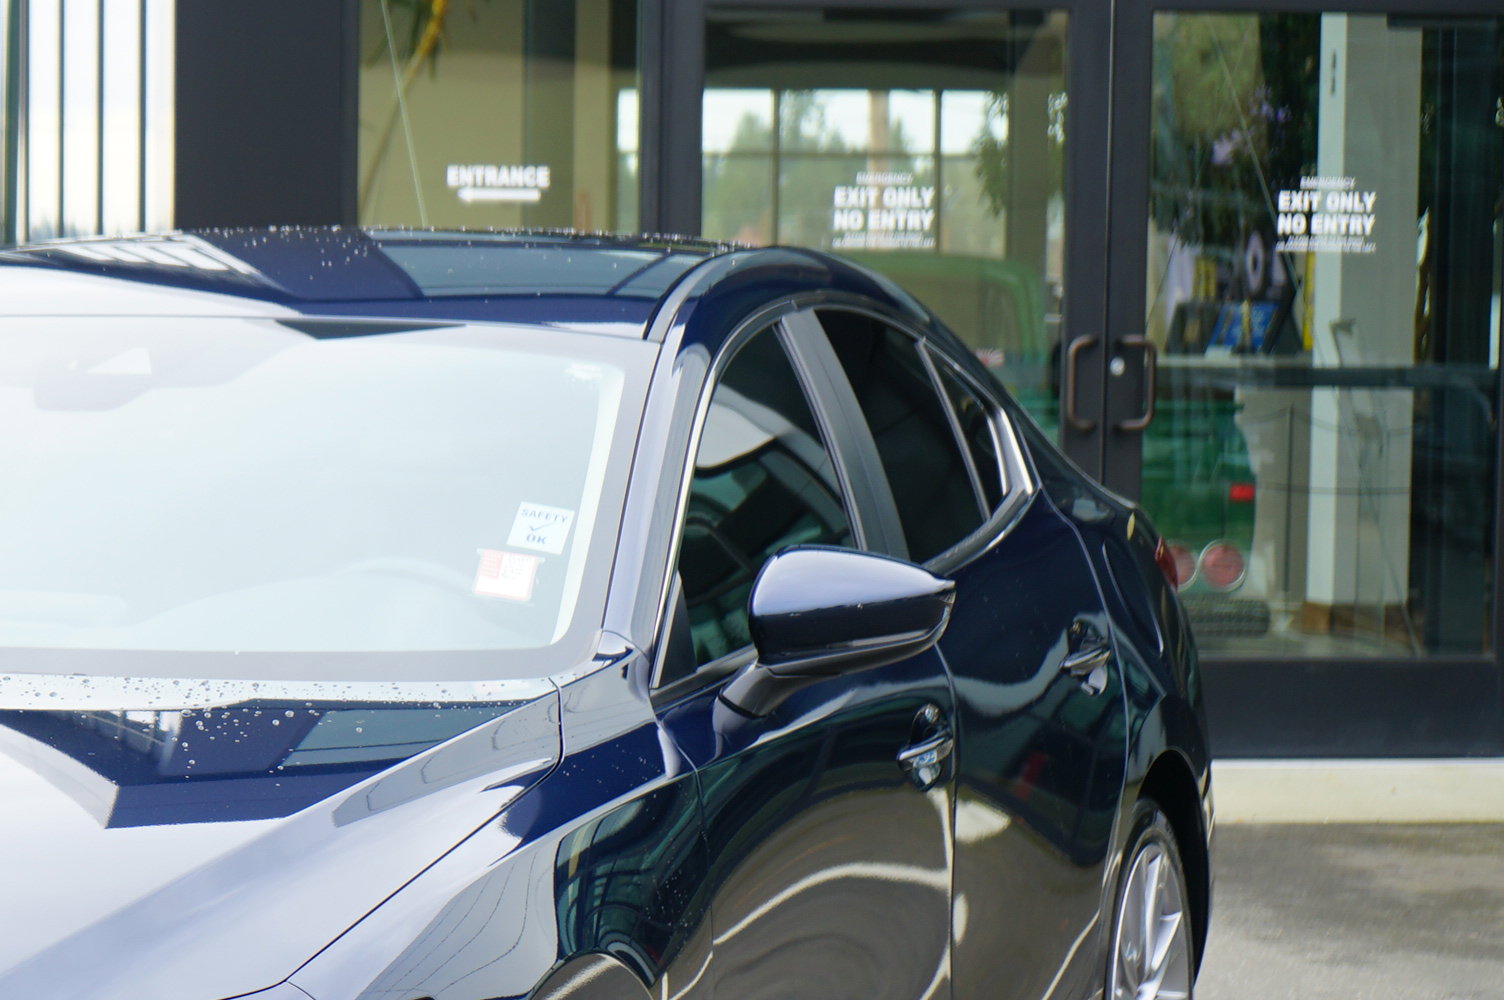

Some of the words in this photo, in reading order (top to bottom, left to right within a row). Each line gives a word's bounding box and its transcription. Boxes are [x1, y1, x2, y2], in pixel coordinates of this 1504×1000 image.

[446, 164, 551, 188] ENTRANCE
[834, 186, 879, 208] EXIT
[883, 186, 935, 208] ONLY
[1278, 190, 1322, 212] EXIT
[1326, 191, 1376, 212] ONLY
[833, 209, 865, 230] NO
[867, 209, 935, 231] ENTRY
[1277, 213, 1308, 235] NO
[1311, 213, 1376, 235] ENTRY
[520, 508, 569, 524] SAFETY
[526, 534, 548, 545] OK
